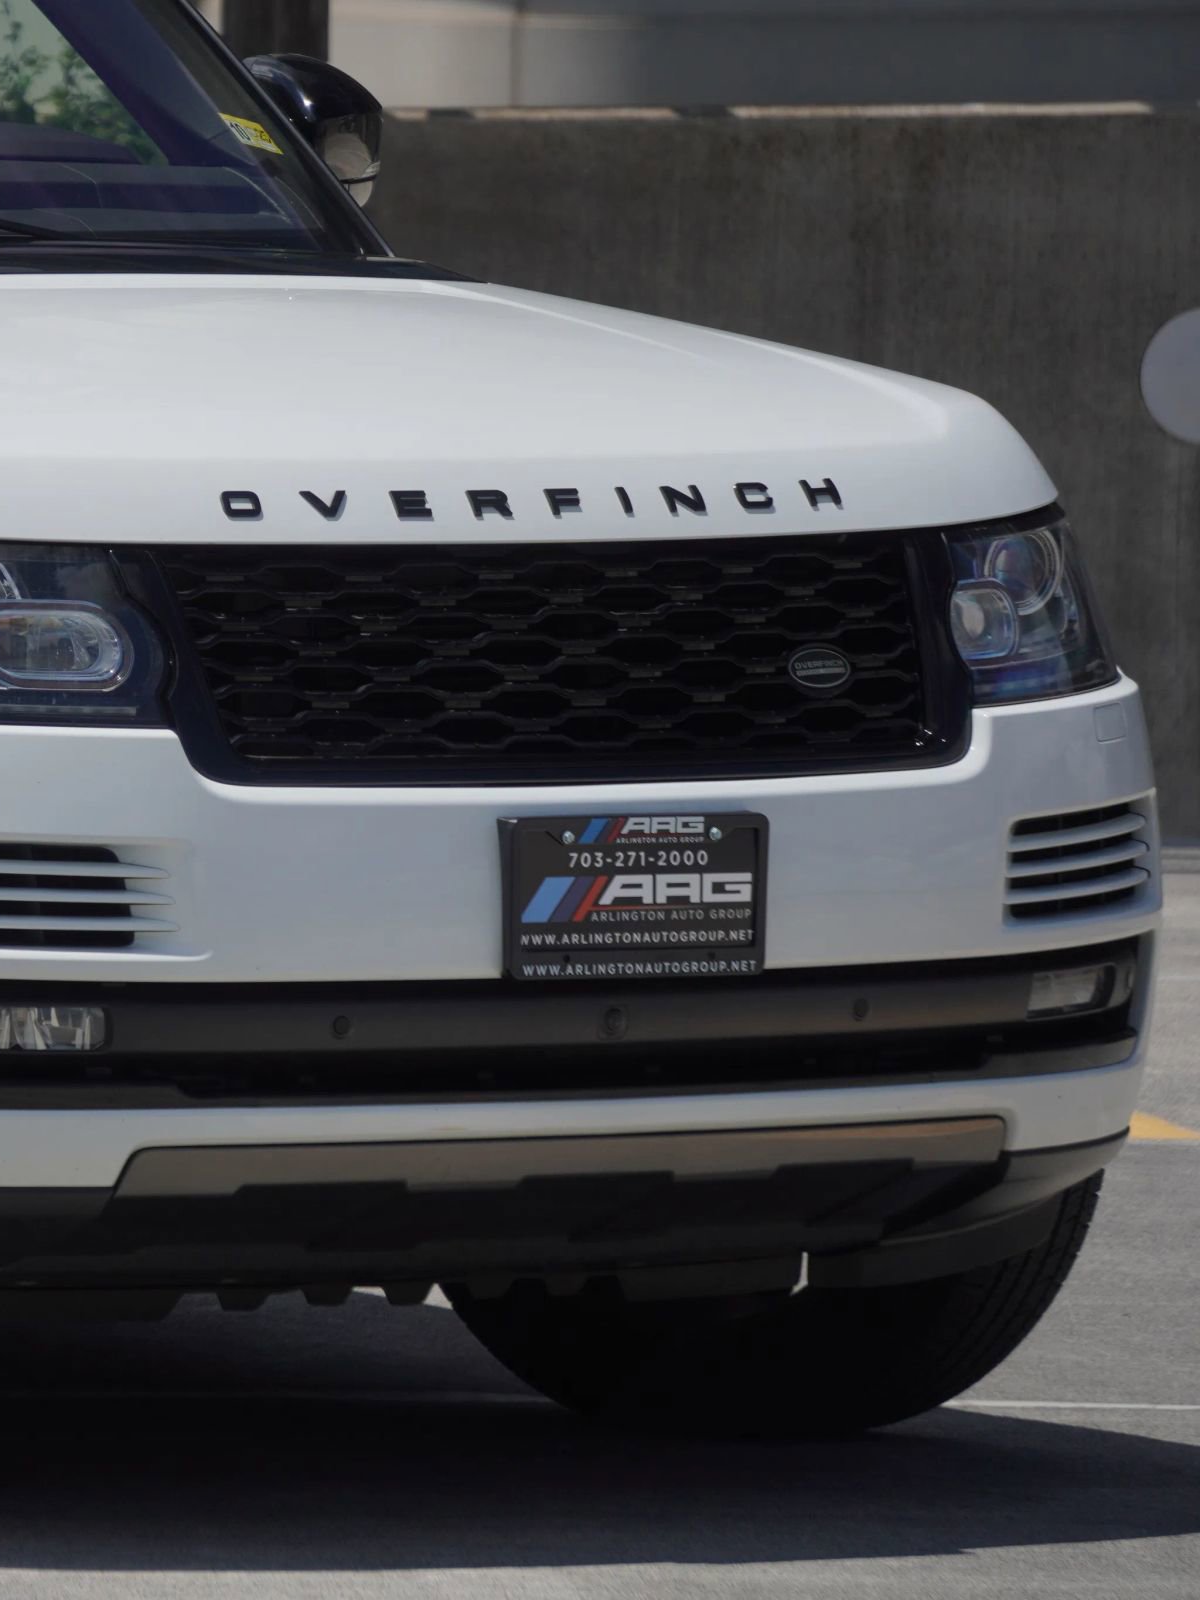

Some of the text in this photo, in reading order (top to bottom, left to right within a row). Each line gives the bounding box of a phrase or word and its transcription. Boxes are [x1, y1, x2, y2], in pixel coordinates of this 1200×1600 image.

[220, 478, 842, 518] OVERFINCH
[616, 836, 657, 844] ARLINGTON
[569, 850, 709, 868] 703-271-2000
[591, 908, 752, 922] ARLINGTON AUTO GROUP
[520, 929, 755, 946] WWW.ARLINGTONAUTOGROUP.NET
[522, 960, 757, 977] WWW.ARLINGTONAUTOGROUP.NET
